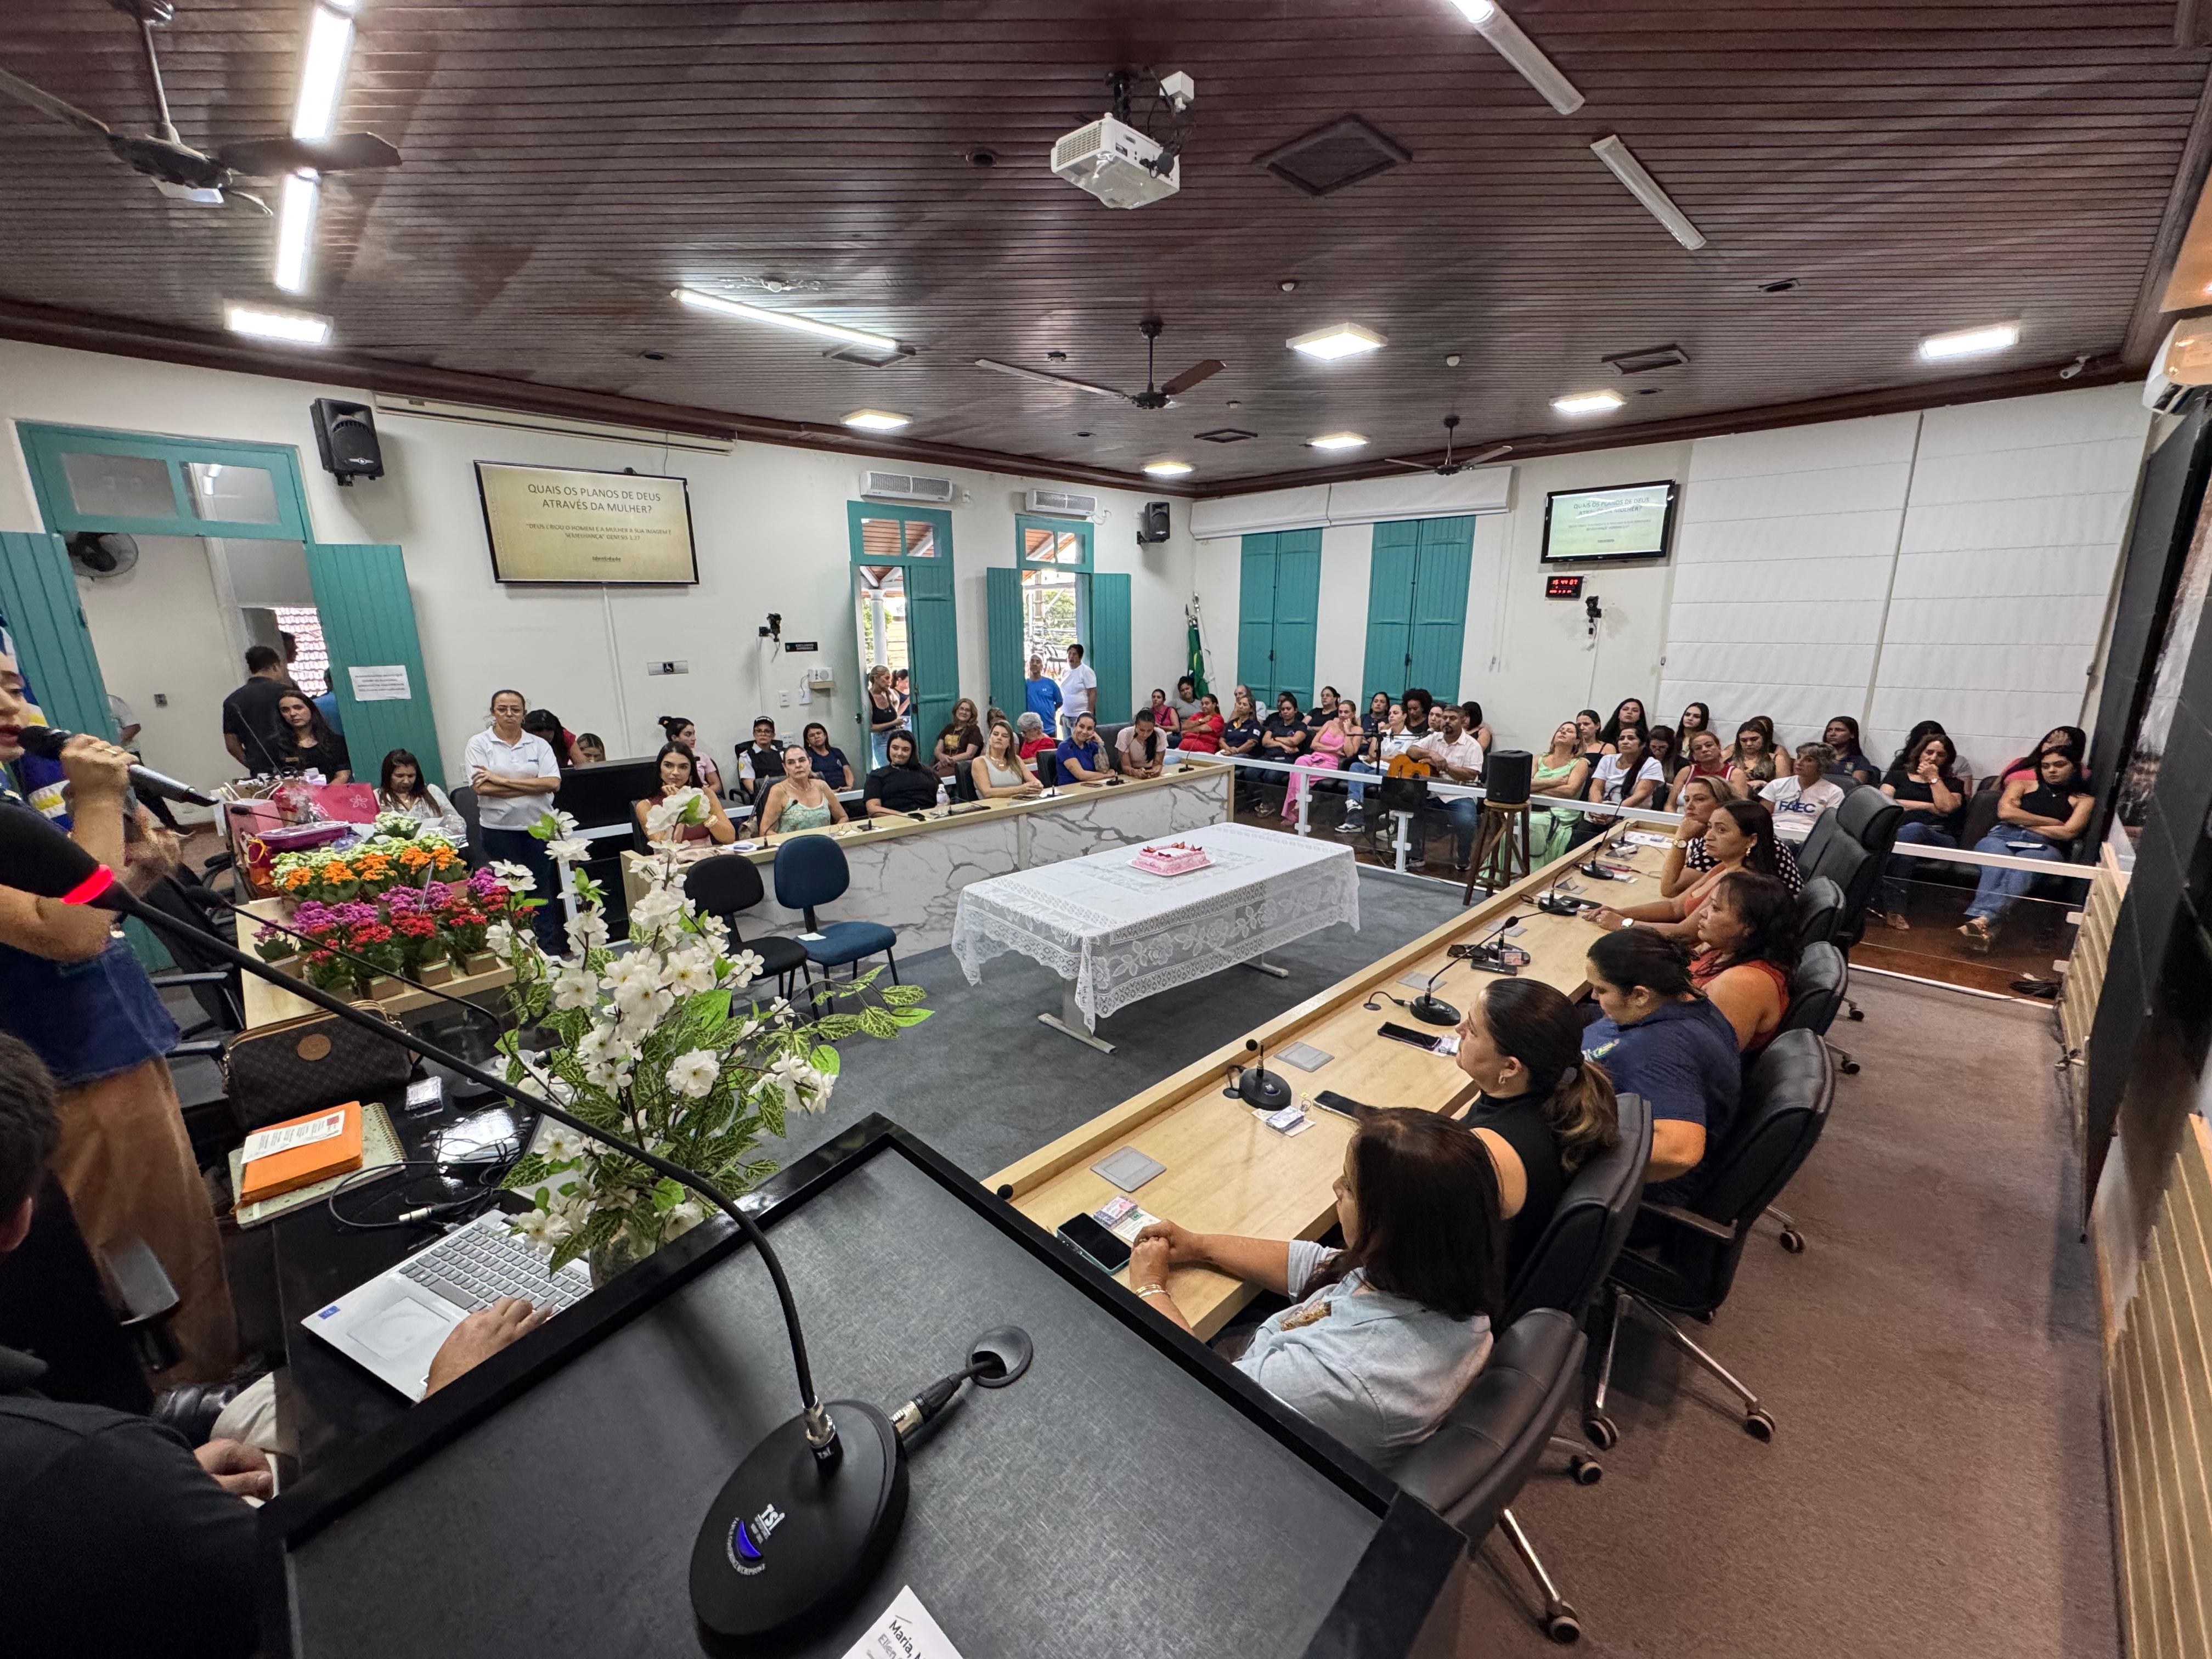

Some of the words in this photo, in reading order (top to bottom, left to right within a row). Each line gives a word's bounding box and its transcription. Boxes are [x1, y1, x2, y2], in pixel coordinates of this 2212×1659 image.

[528, 484, 561, 494] QUAIS
[564, 487, 578, 495] OS
[580, 488, 619, 499] PLANOS
[622, 491, 634, 499] DE
[637, 492, 661, 501] DEUS
[543, 499, 588, 510] ATRAVÉS
[591, 503, 605, 511] DA
[607, 504, 652, 514] MULHER?
[889, 1619, 913, 1658] Maria,
